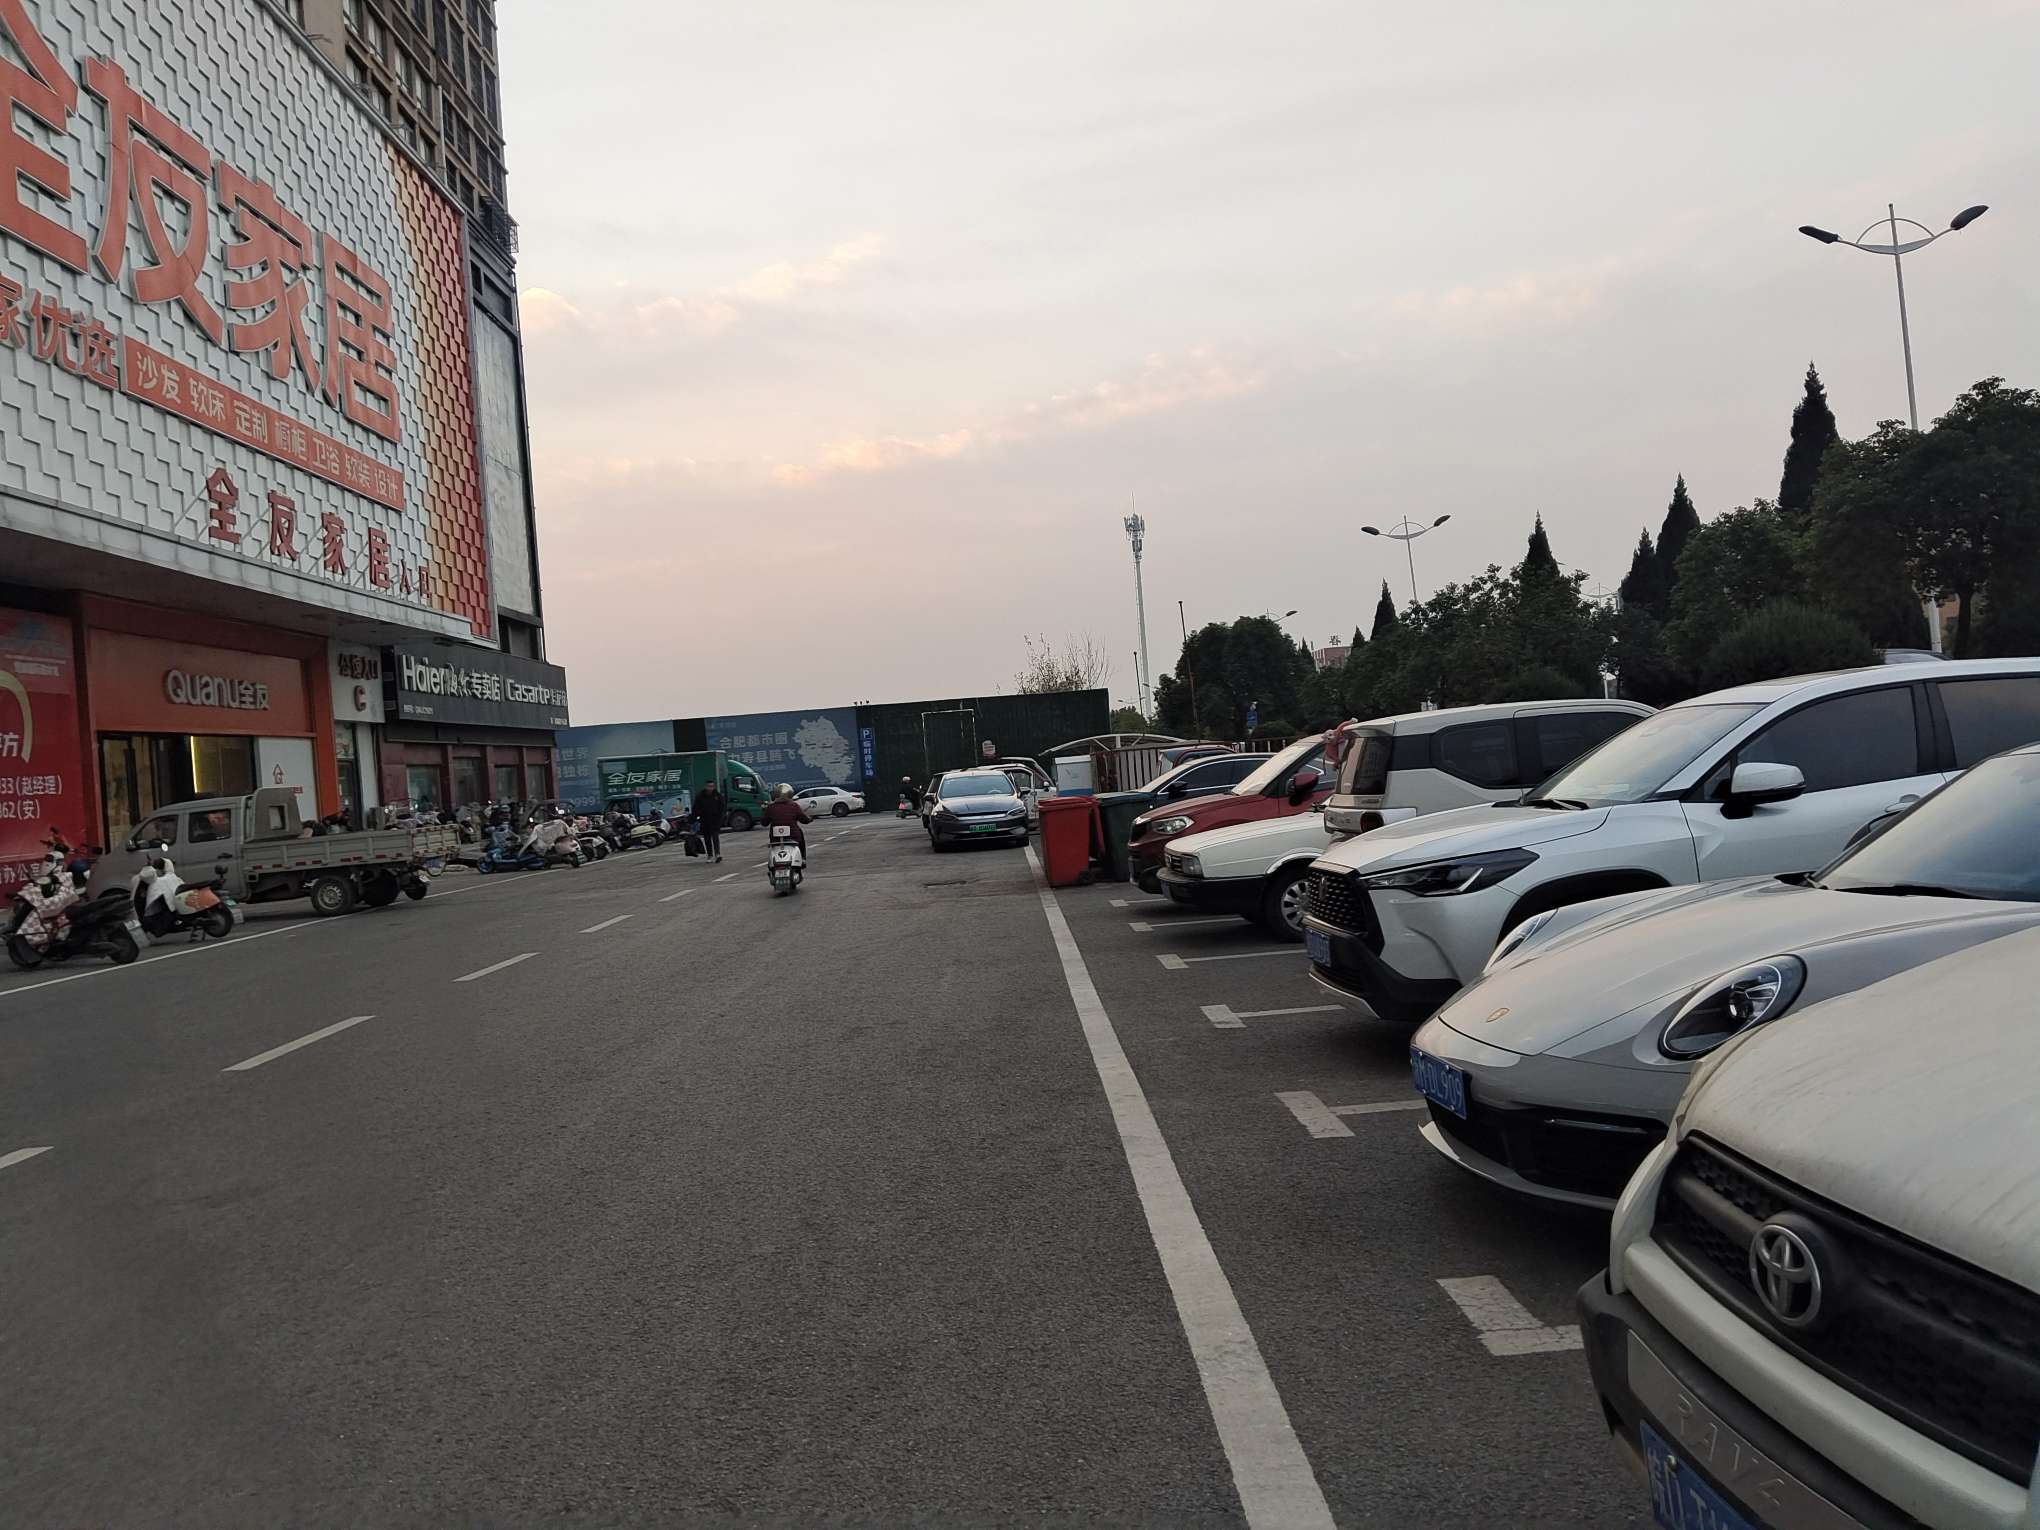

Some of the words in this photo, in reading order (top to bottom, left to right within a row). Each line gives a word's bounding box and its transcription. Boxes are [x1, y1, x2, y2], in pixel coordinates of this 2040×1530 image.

[136, 351, 181, 404] 沙发
[188, 377, 226, 422] 软床
[234, 399, 269, 444] 定制
[274, 419, 308, 462] 橱柜
[312, 436, 341, 476] 卫浴
[373, 468, 399, 498] 设计
[0, 732, 19, 757] 方
[607, 769, 682, 785] 全友家居
[0, 799, 40, 820] 62(安)
